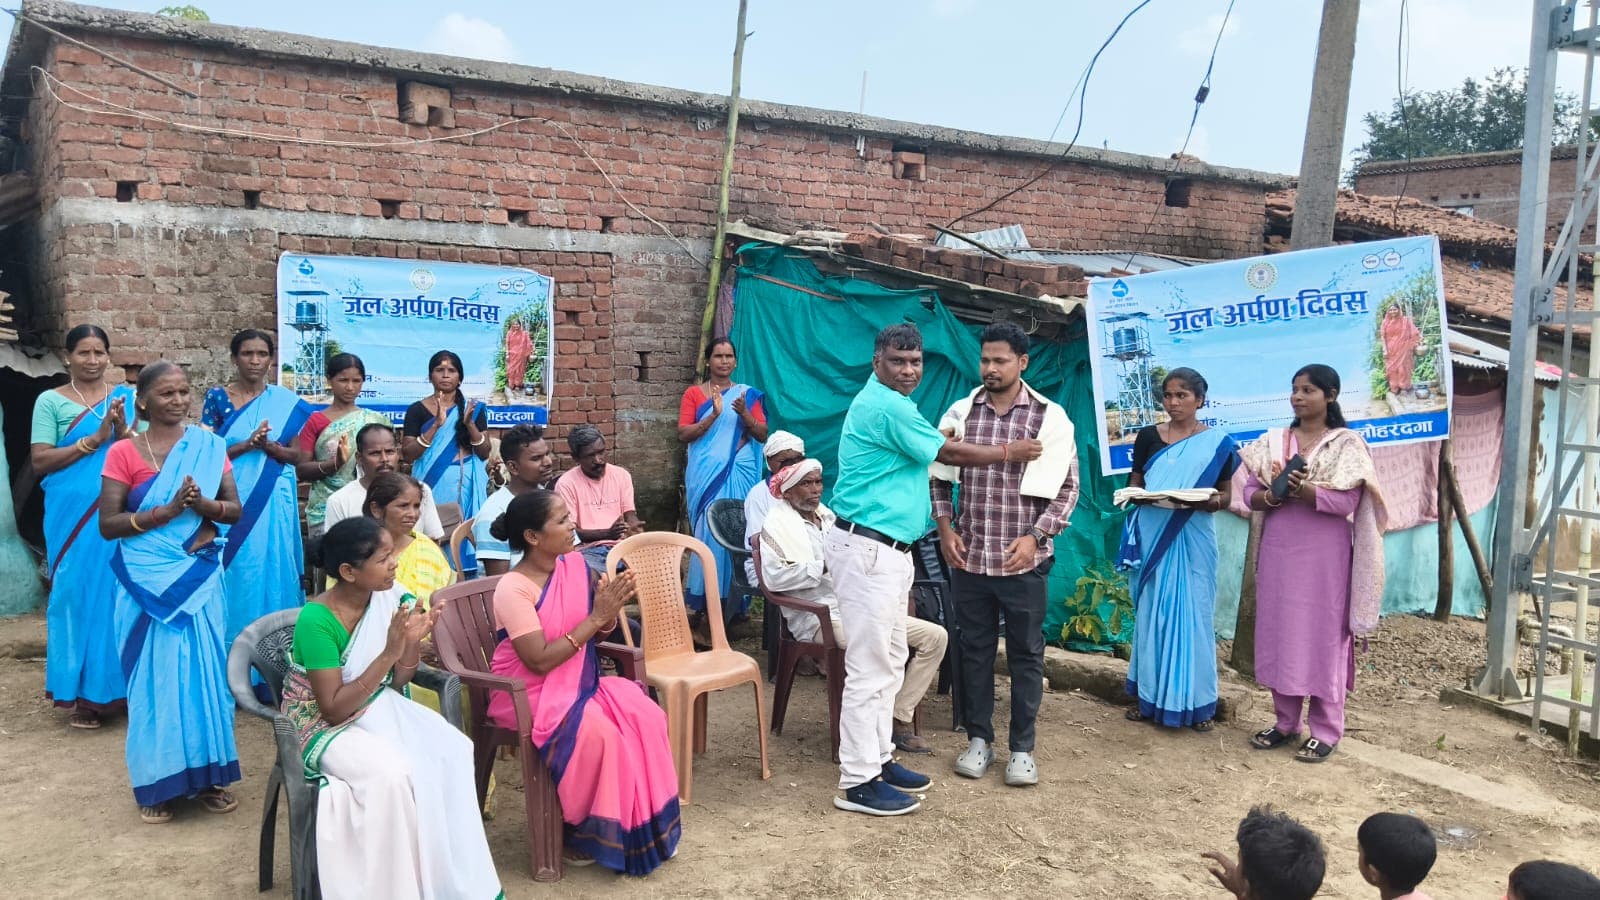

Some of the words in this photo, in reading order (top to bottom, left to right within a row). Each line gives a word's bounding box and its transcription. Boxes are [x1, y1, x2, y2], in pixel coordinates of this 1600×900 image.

[342, 296, 384, 315] जल
[390, 295, 443, 317] अर्पण
[448, 297, 500, 321] दिवस
[1164, 307, 1214, 332] जल
[1223, 295, 1291, 324] अर्पण
[1296, 289, 1368, 316] दिवस
